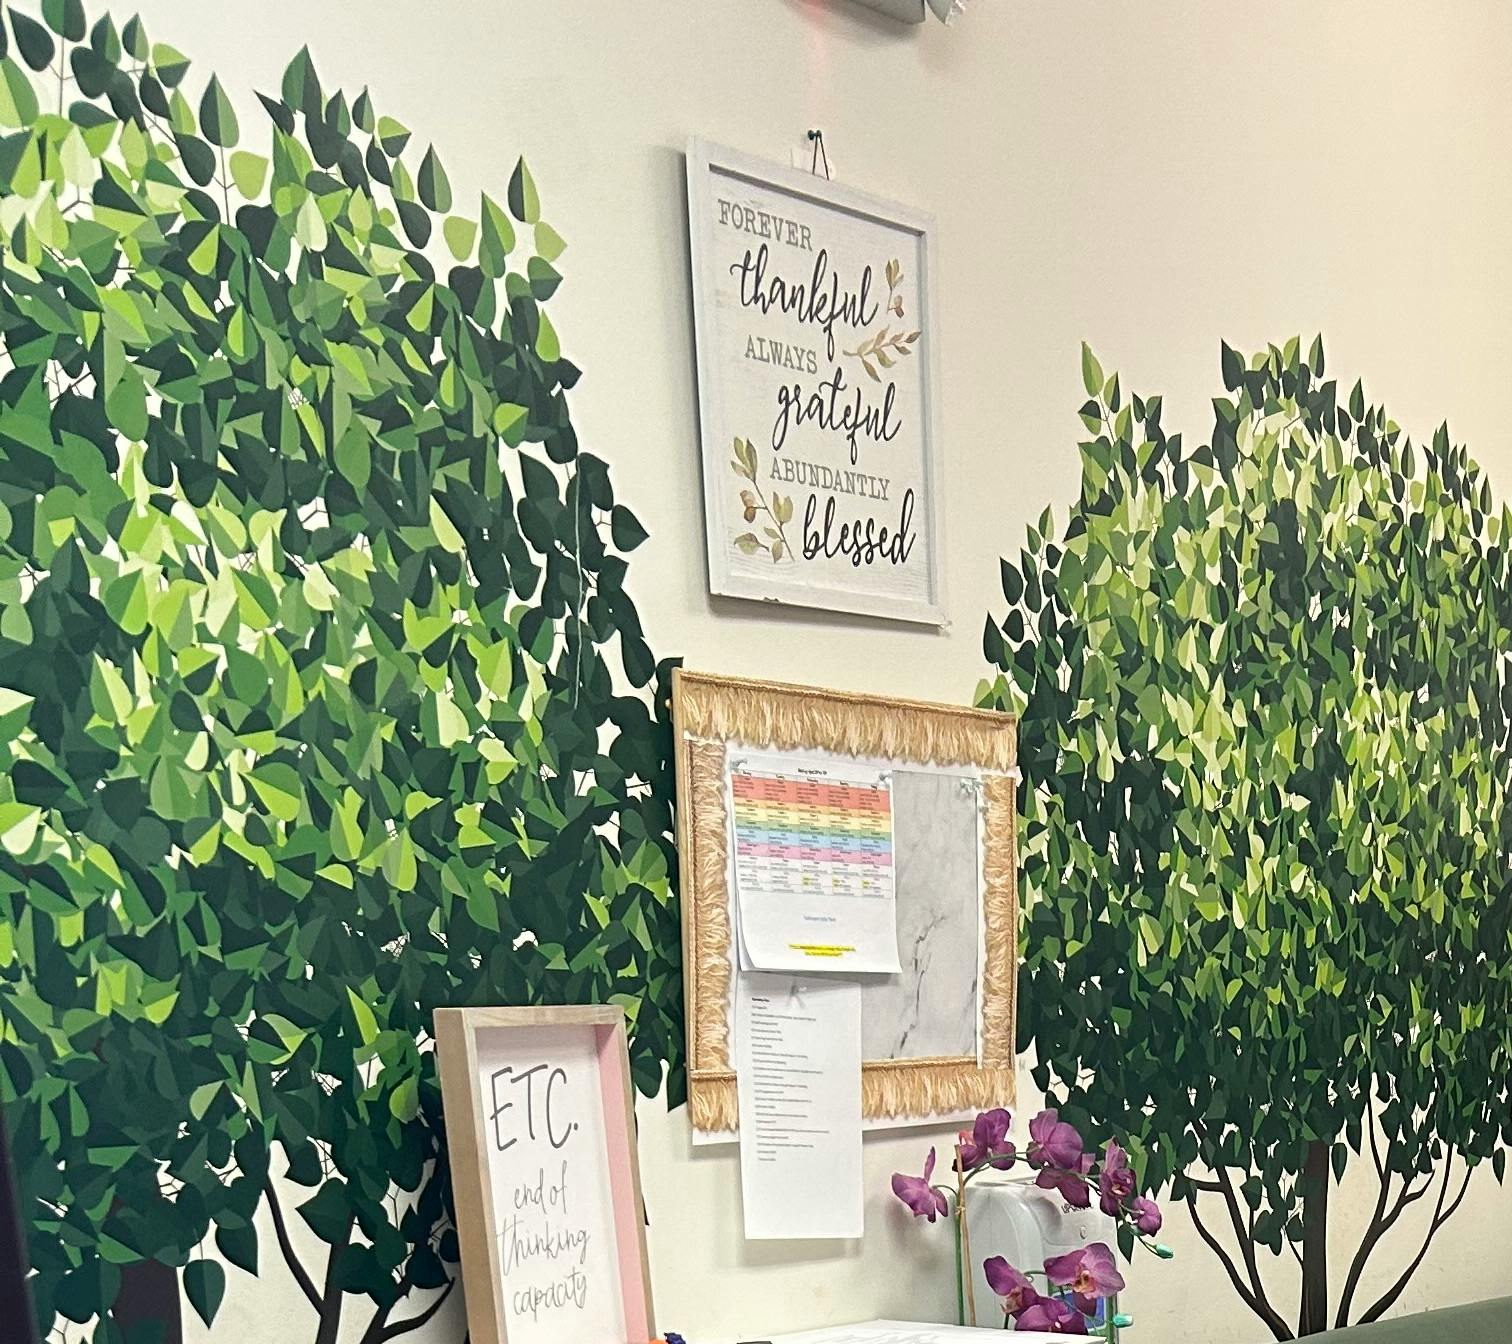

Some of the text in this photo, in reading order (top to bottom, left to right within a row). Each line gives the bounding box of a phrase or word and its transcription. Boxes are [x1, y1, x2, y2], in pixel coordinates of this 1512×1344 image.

[717, 199, 813, 251] FOREVER
[730, 243, 879, 362] thankful
[744, 335, 818, 374] ALWAYS
[771, 366, 901, 465] grateful
[769, 456, 890, 501] ABUNDANTLY
[802, 487, 916, 567] blessed
[490, 1064, 579, 1151] ETC.
[514, 1160, 568, 1215] end of
[496, 1214, 591, 1276] thinking
[513, 1266, 587, 1323] capacity
